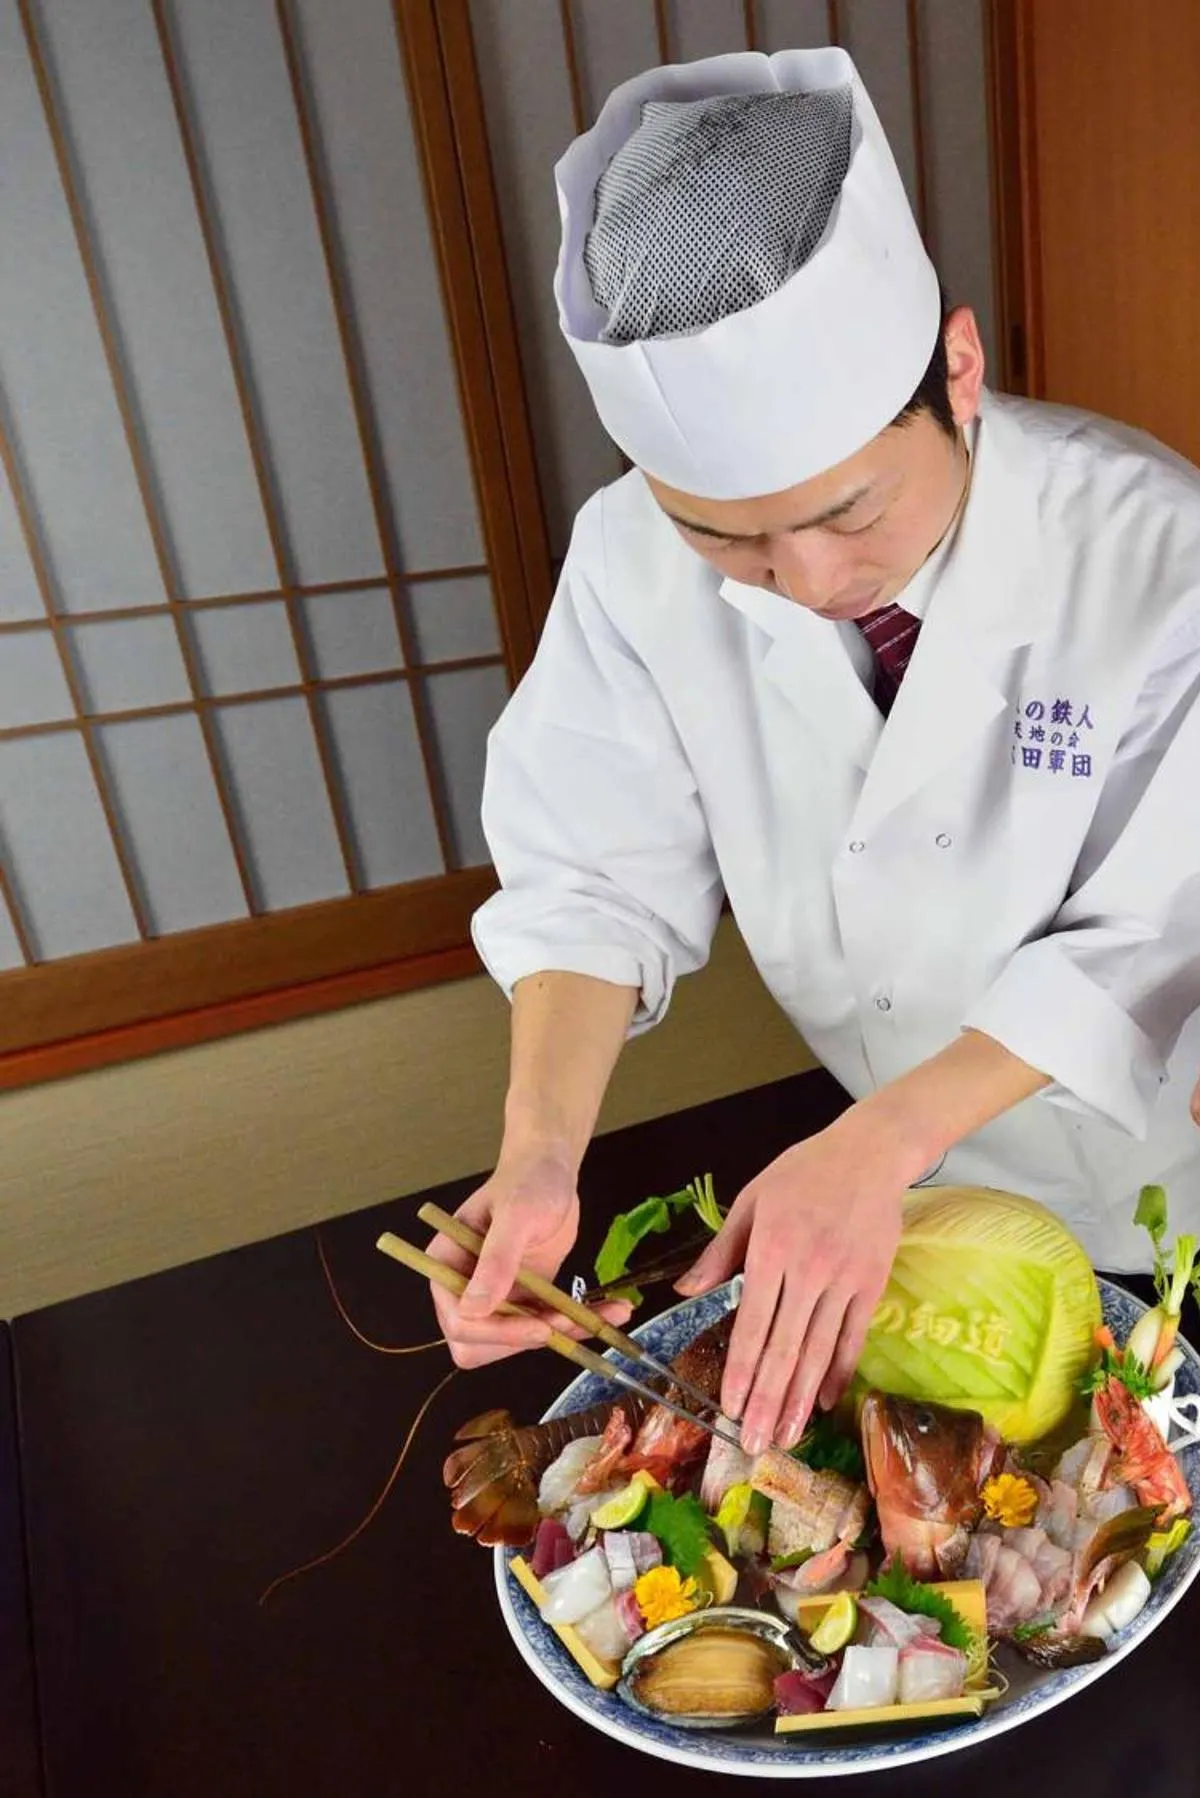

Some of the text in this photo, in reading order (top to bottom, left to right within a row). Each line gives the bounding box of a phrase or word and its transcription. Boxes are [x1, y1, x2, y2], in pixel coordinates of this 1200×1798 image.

[1016, 698, 1093, 729] の鉄人
[1010, 744, 1092, 777] 田軍団
